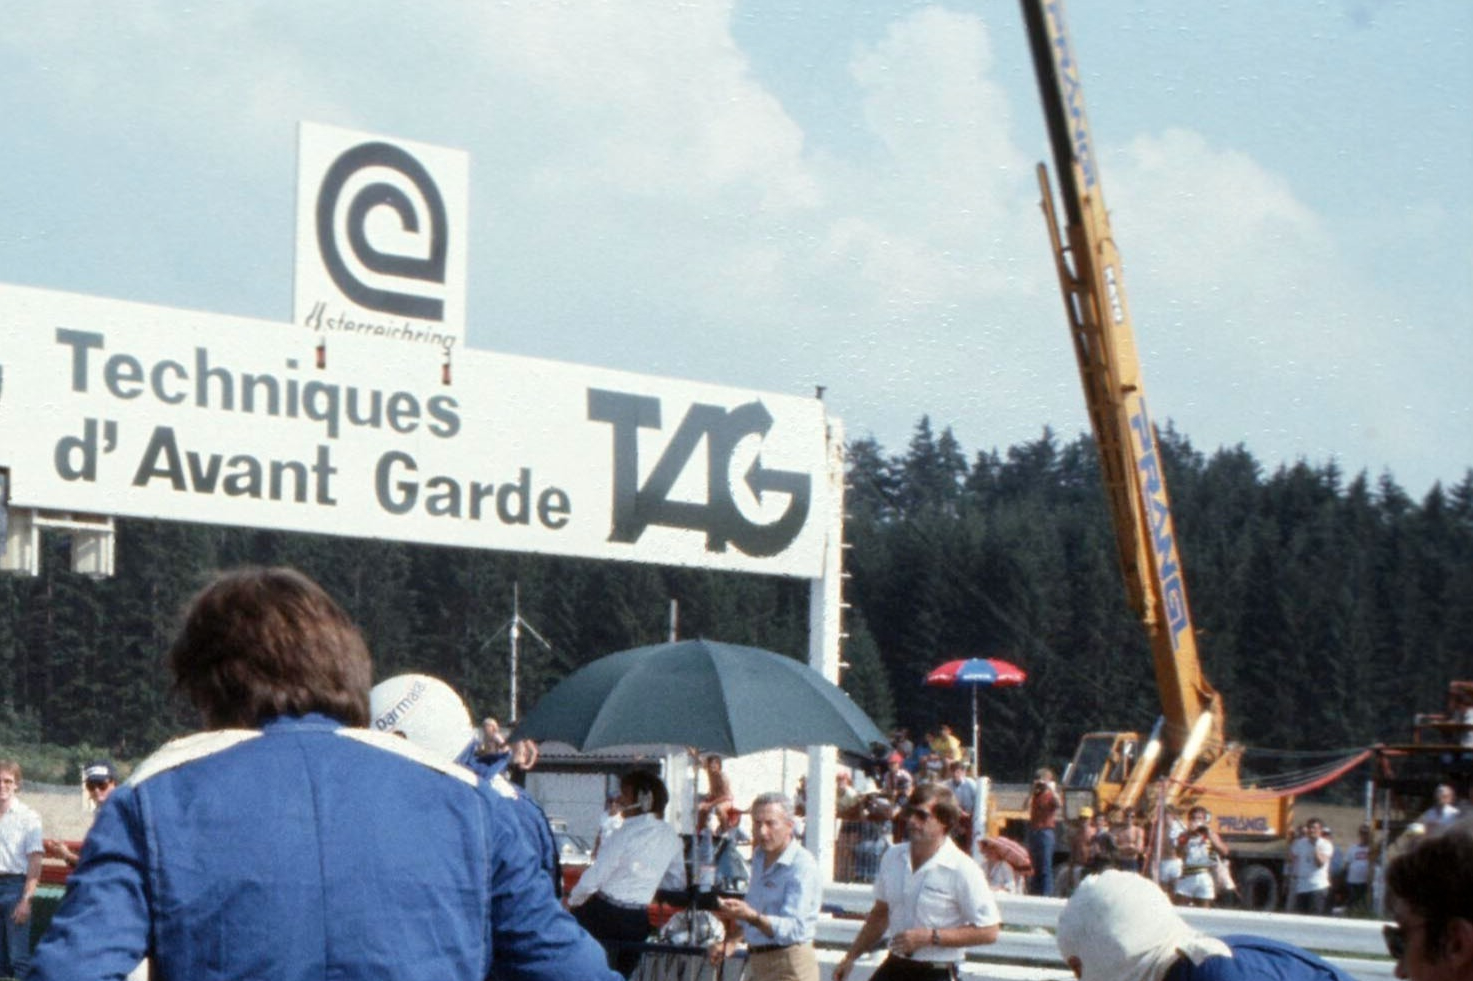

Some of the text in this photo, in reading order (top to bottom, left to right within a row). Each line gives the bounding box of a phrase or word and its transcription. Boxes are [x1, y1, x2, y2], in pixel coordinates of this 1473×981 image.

[55, 327, 462, 440] Techniques
[374, 450, 572, 530] Garde
[586, 387, 812, 558] TAG
